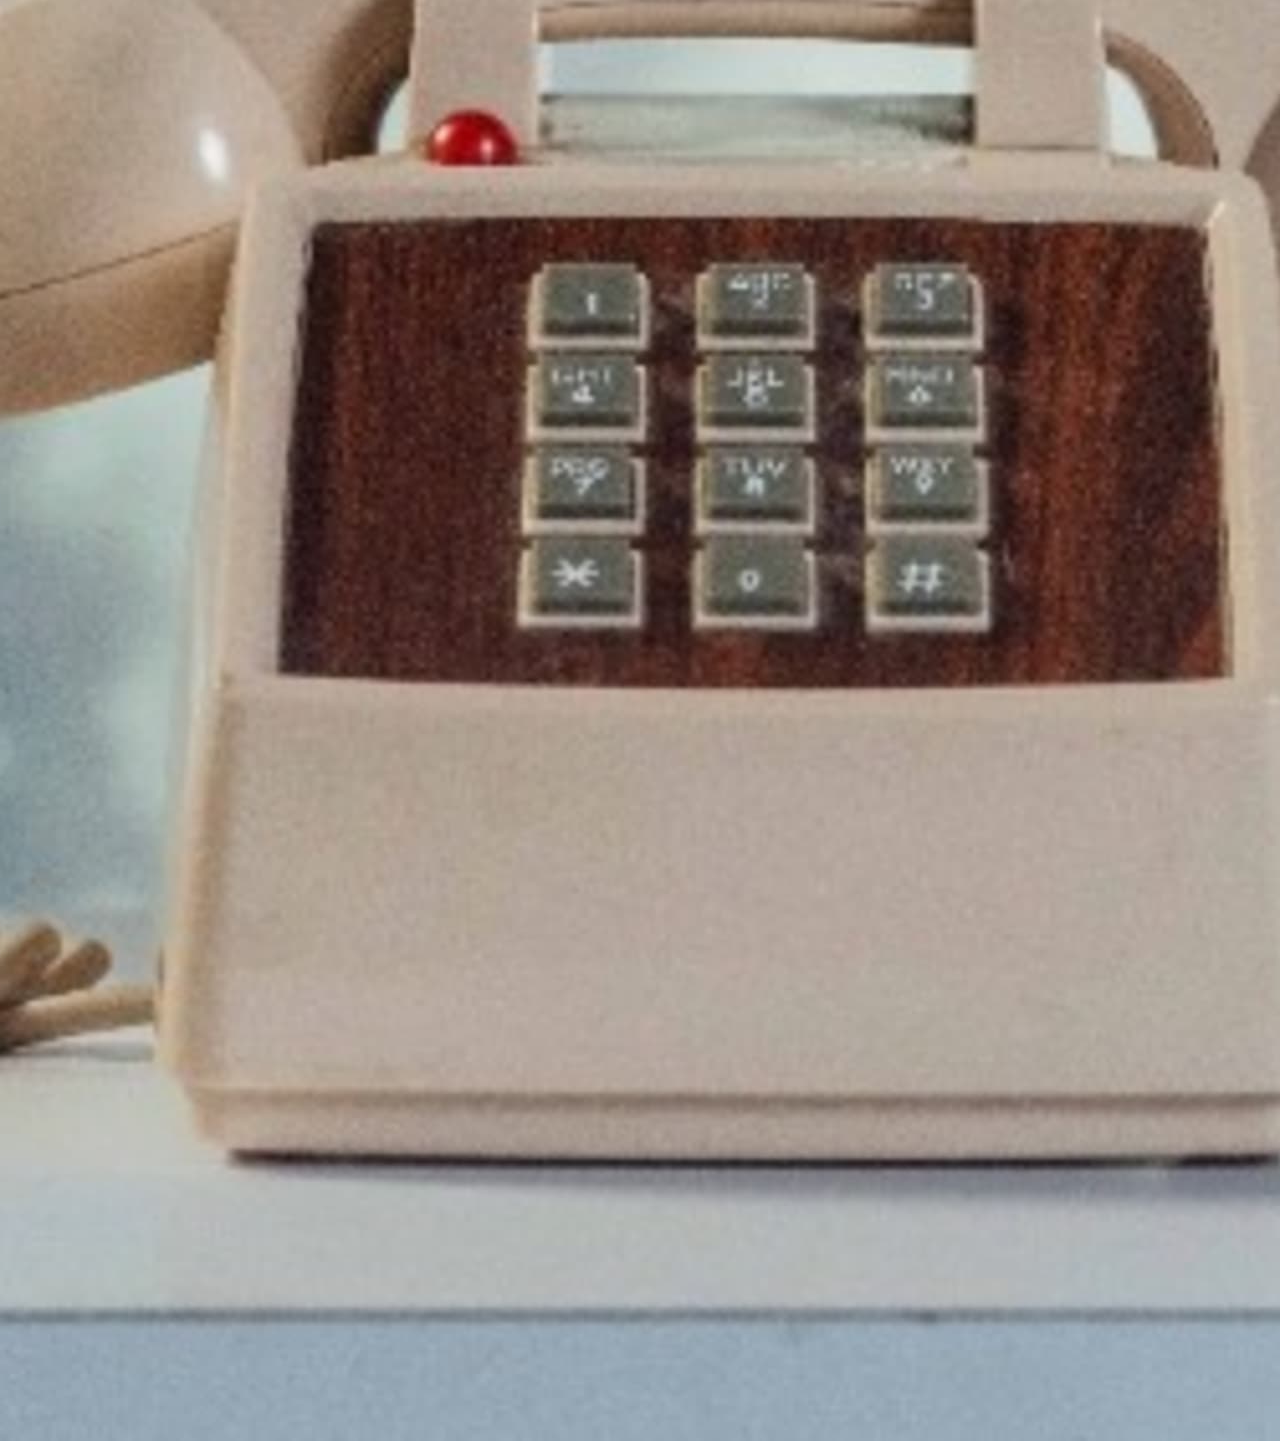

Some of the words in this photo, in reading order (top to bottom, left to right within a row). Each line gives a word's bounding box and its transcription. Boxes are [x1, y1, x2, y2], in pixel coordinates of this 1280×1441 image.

[585, 291, 598, 315] 1
[723, 457, 787, 478] TUV
[574, 477, 596, 496] 7
